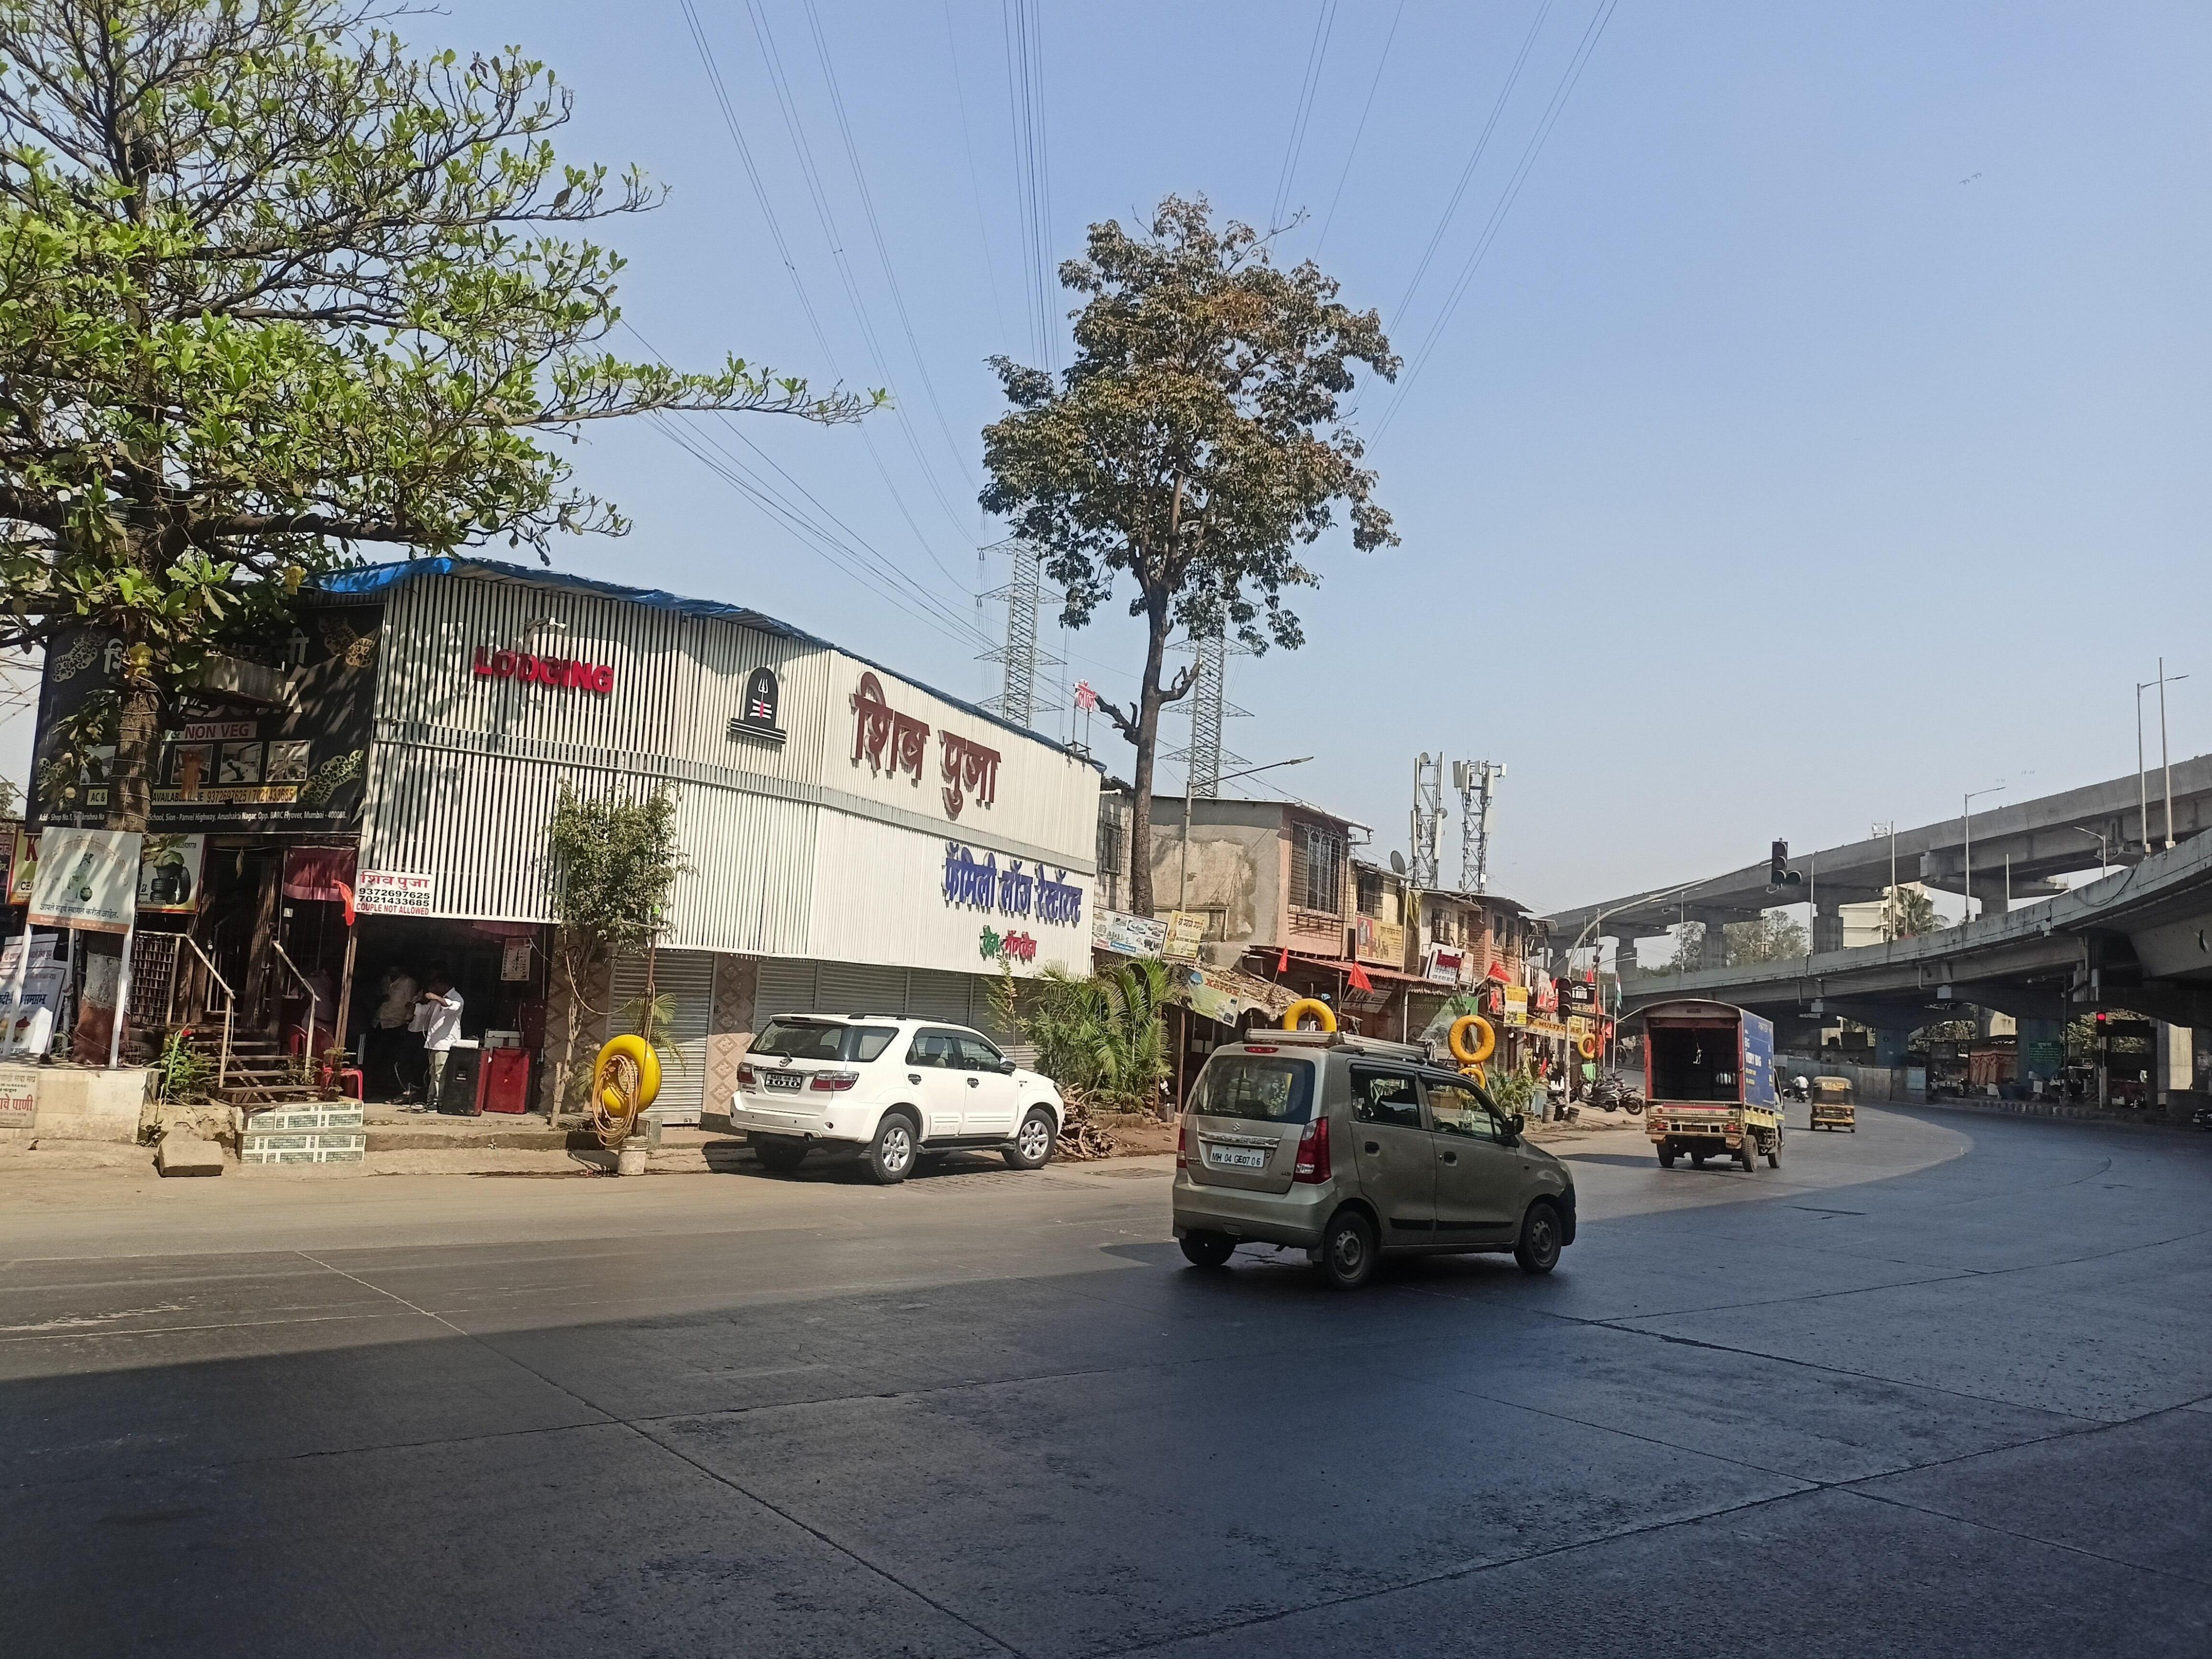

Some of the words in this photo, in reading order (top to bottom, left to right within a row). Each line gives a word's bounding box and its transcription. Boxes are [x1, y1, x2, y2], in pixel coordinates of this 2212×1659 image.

[474, 645, 613, 693] LODGING
[185, 725, 216, 739] NON
[222, 724, 249, 737] VEG
[849, 671, 931, 780] शिव
[938, 729, 1001, 814] पुजा
[90, 792, 99, 802] AC
[100, 792, 106, 802] &
[253, 788, 293, 802] 7021433685
[51, 814, 61, 822] Shop
[179, 813, 194, 821] Panvel
[241, 812, 257, 822] Nagar,
[258, 812, 269, 821] Opp.
[360, 871, 395, 885] शिव
[397, 877, 430, 890] पुजा
[998, 859, 1033, 914] लॉज
[358, 895, 429, 906] 7021433685
[359, 888, 430, 900] 9372697625
[356, 902, 382, 912] COUPLE
[384, 905, 397, 913] NOT
[399, 906, 429, 915] ALLOWED
[1204, 978, 1240, 997] Xerox
[1561, 1025, 1581, 1034] CRS
[767, 1079, 800, 1087] 1010
[13, 1094, 33, 1111] पाणी
[1211, 1152, 1222, 1162] MH
[1224, 1153, 1232, 1163] 04
